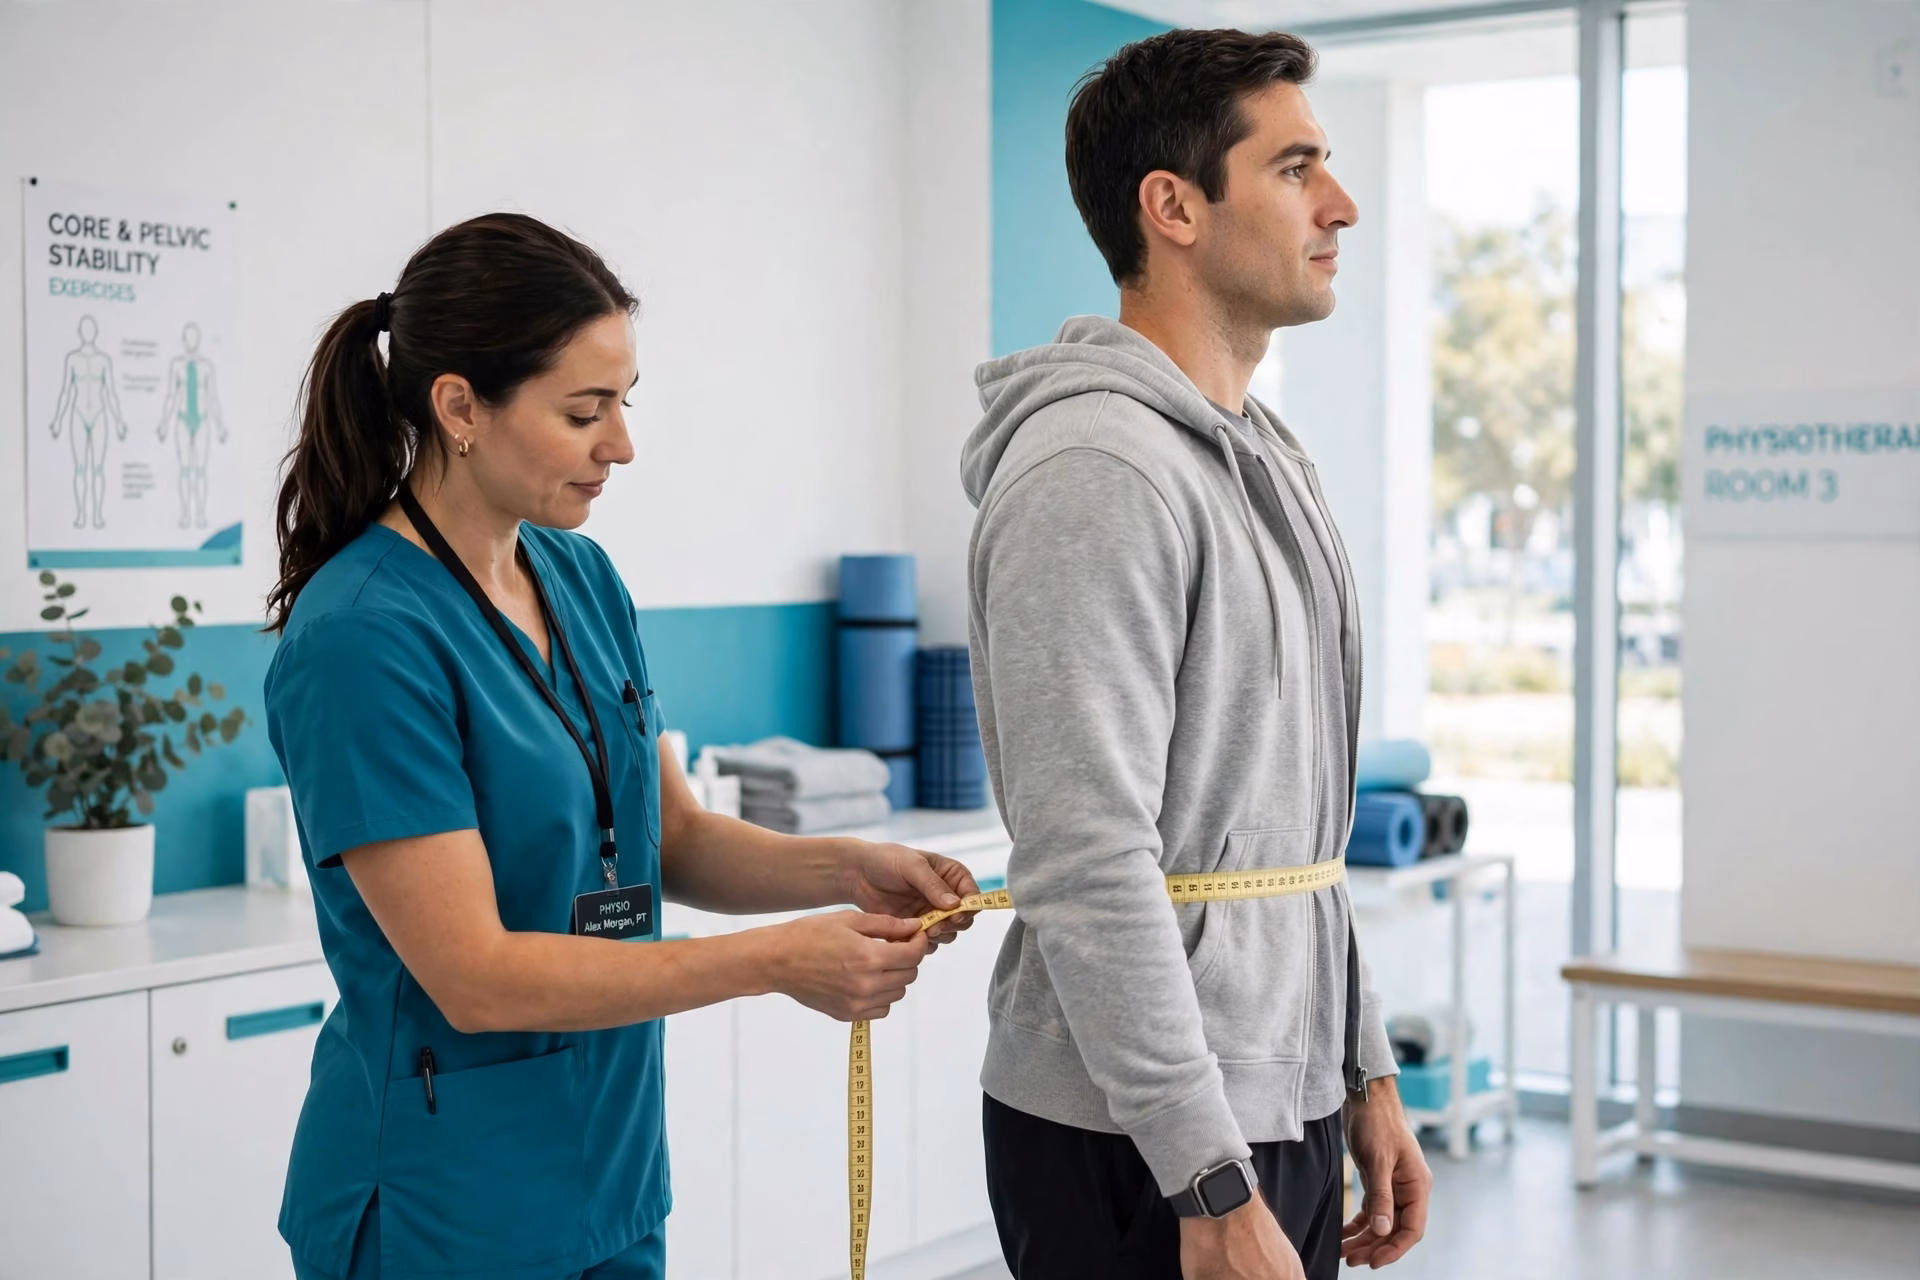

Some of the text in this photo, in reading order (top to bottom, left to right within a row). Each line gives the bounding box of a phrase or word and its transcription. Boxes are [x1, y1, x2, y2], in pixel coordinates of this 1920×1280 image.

[48, 213, 211, 251] CORE & PELVIC
[48, 244, 160, 275] STABILITY
[48, 277, 136, 302] EXERCISES
[1704, 468, 1840, 503] ROOM 3
[599, 900, 630, 915] PHYSIO
[584, 912, 646, 933] Alex Morgan, PT
